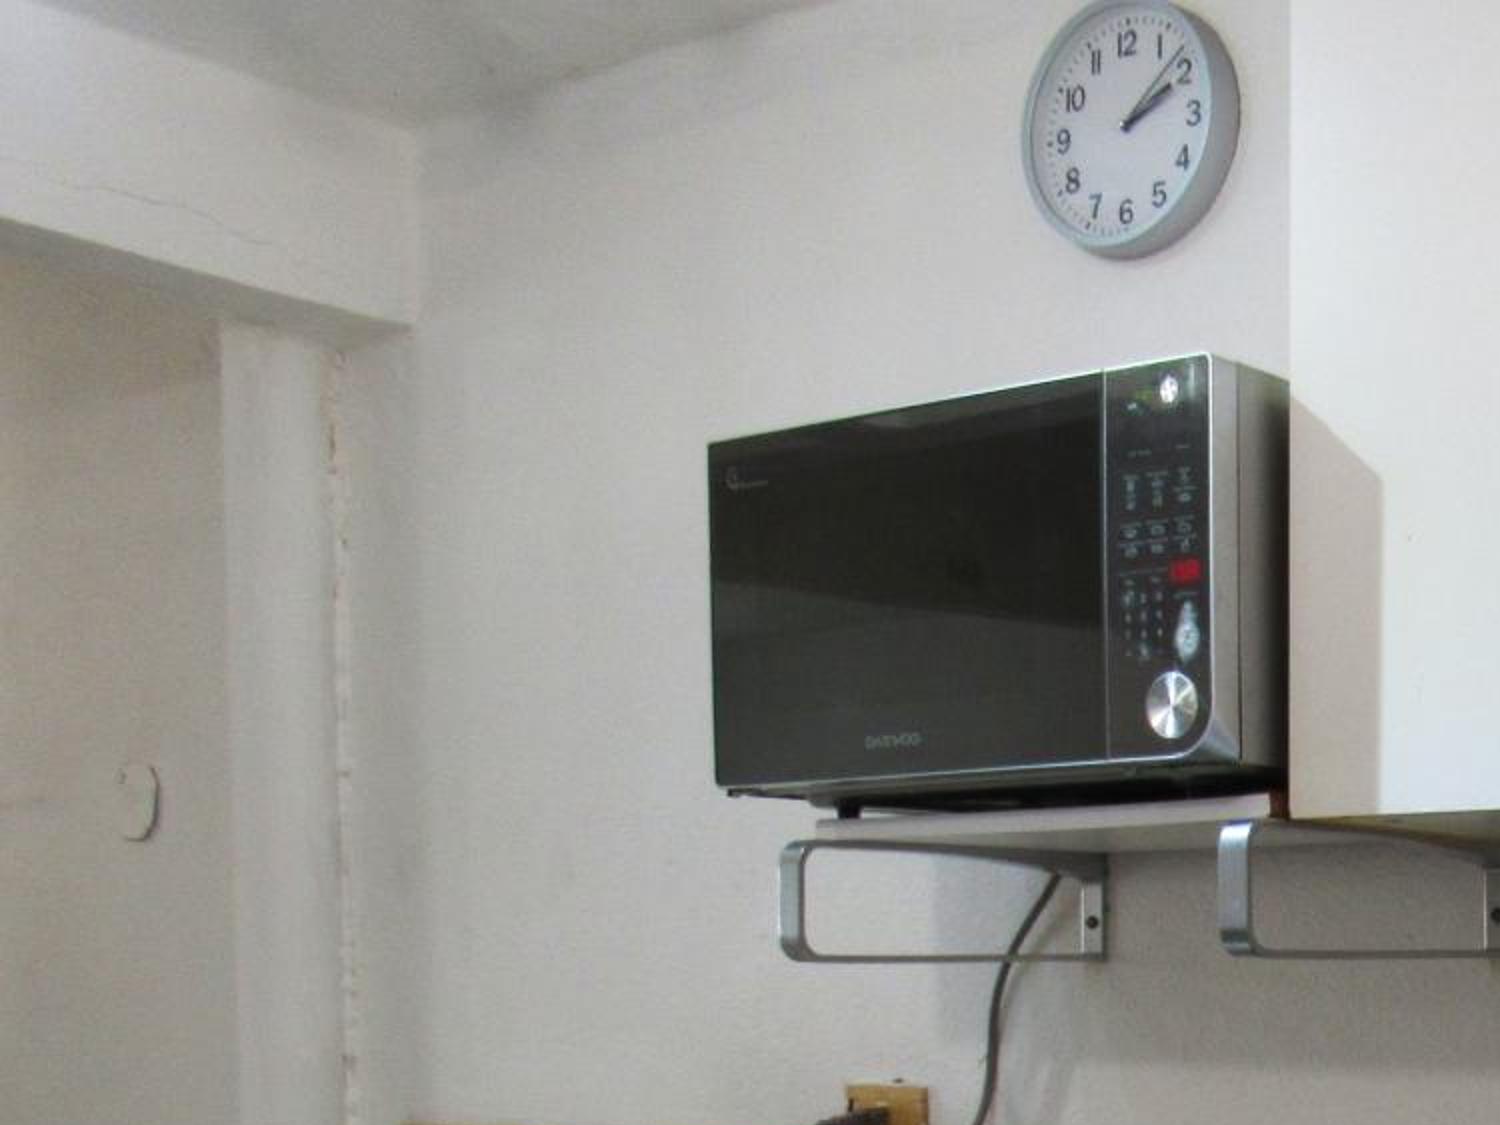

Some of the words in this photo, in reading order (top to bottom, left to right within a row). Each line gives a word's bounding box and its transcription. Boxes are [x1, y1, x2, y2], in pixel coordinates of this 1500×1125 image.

[1117, 29, 1138, 58] 12
[1157, 33, 1163, 59] 1
[1090, 48, 1101, 76] 11
[1176, 58, 1193, 85] 2
[1065, 85, 1086, 112] 10
[1186, 99, 1202, 127] 3
[1057, 128, 1071, 155] 9
[1175, 144, 1190, 171] 4
[1065, 167, 1081, 194] 8
[1089, 192, 1103, 219] 7
[1152, 180, 1167, 209] 5
[1119, 198, 1134, 225] 6
